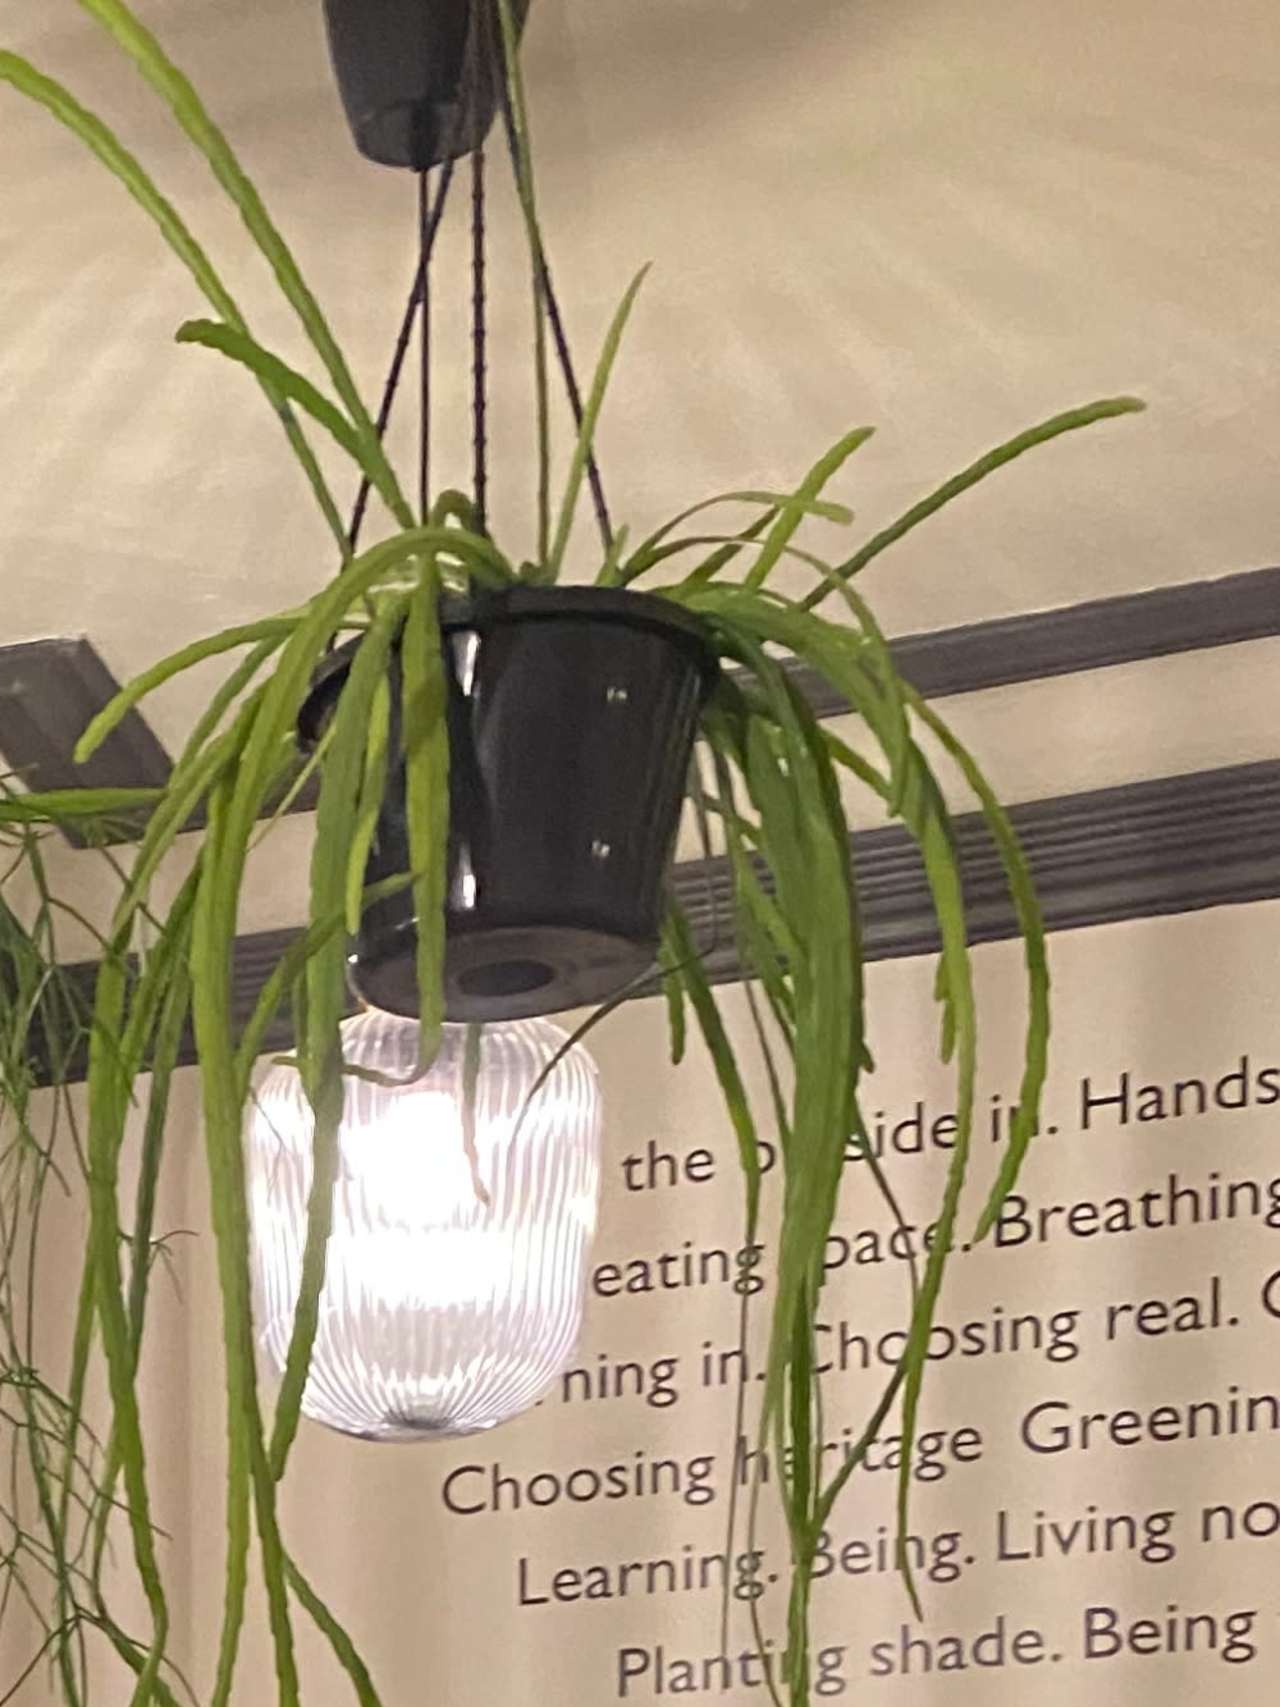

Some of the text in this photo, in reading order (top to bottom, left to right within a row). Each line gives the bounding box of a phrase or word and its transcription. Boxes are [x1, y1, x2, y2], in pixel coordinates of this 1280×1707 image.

[622, 1139, 715, 1191] the
[1081, 1055, 1280, 1130] Hands
[702, 1341, 767, 1388] in.
[1107, 1276, 1239, 1340] real.
[442, 1451, 716, 1515] Choosing
[518, 1545, 778, 1605] Learning.
[997, 1505, 1176, 1564] Living
[618, 1604, 1258, 1697] Plantig shade. Being
